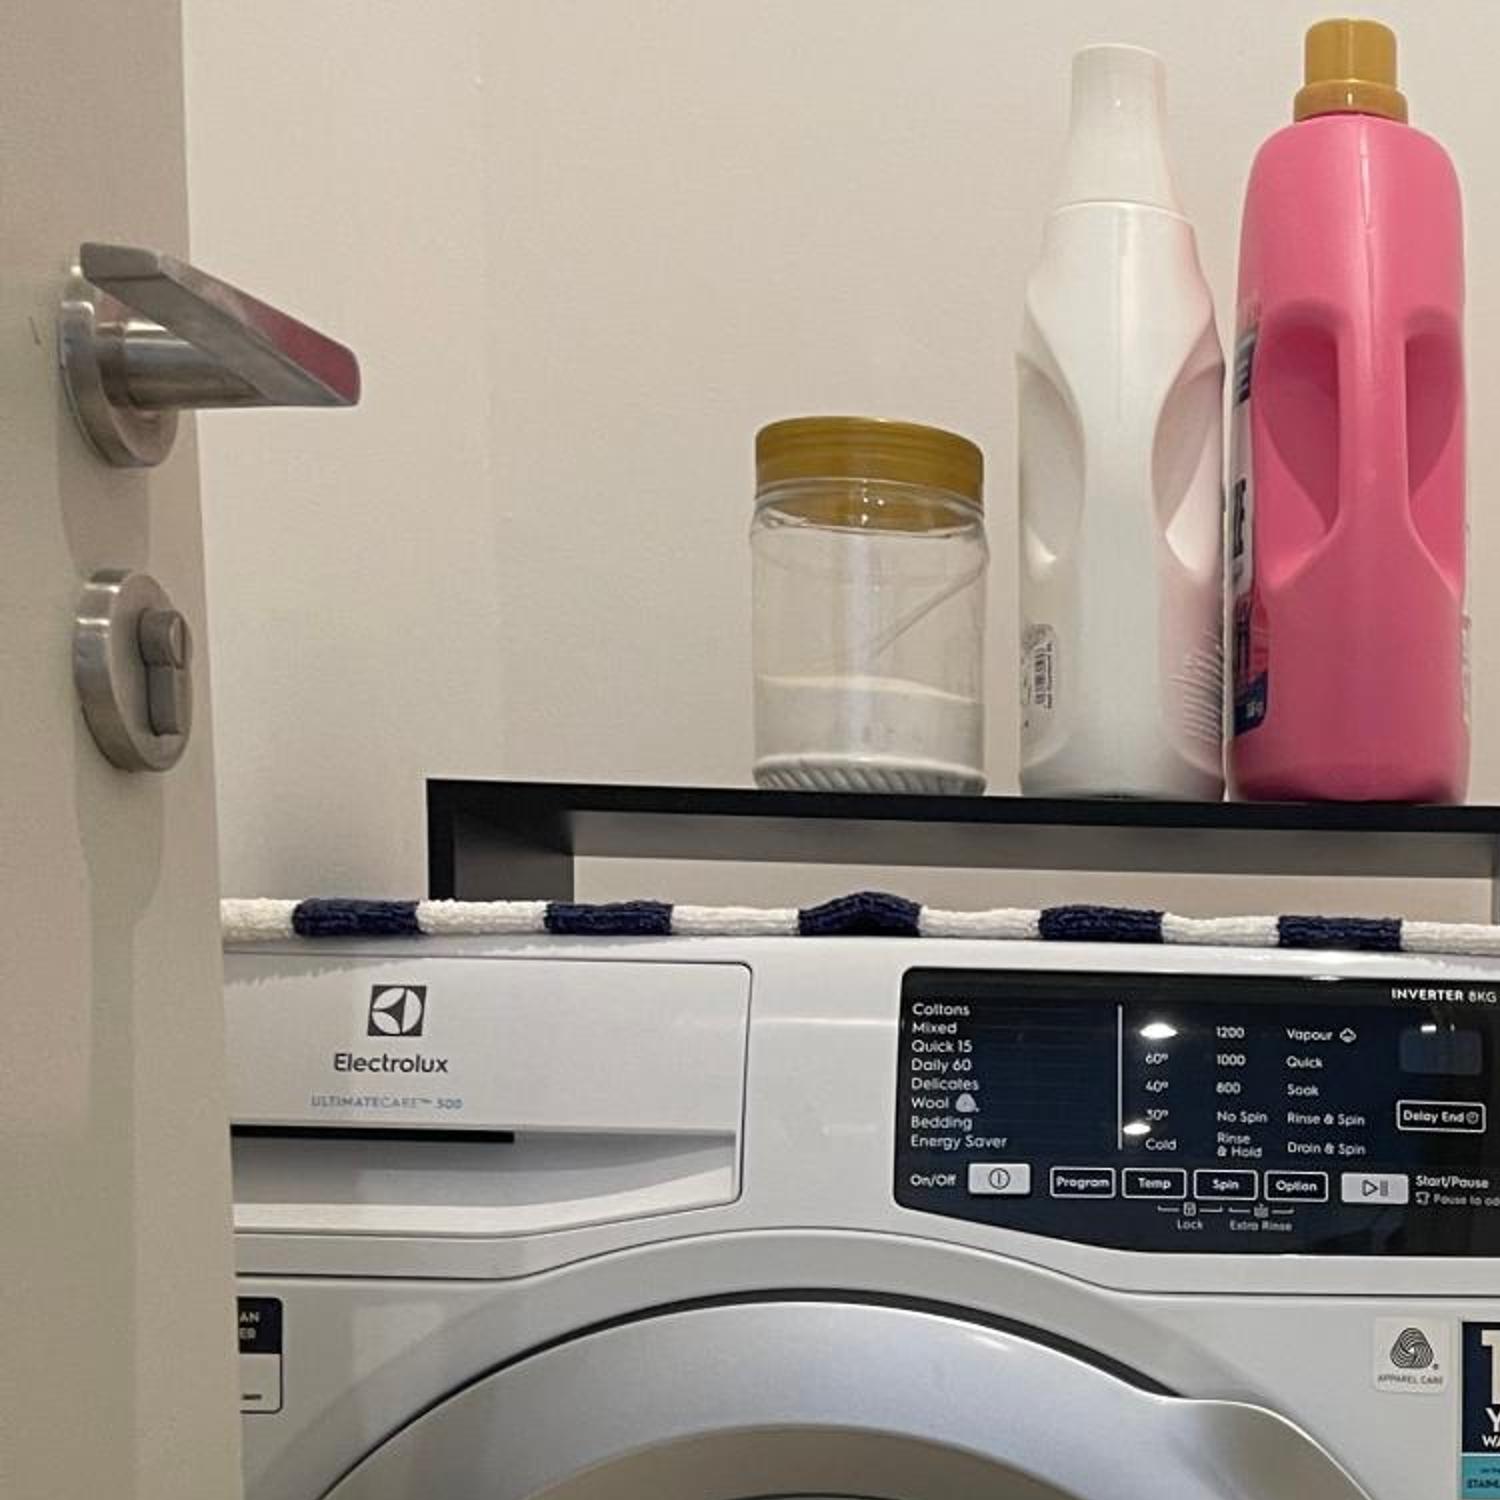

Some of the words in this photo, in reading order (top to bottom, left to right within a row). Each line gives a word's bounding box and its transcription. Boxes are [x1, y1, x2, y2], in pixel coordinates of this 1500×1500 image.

[1391, 988, 1463, 1002] INVERTER
[1468, 991, 1497, 1003] 8KG
[911, 1003, 971, 1016] Cottons
[911, 1022, 958, 1035] Mixed
[1216, 1026, 1245, 1038] 1200
[1286, 1028, 1333, 1042] Vapour
[911, 1040, 954, 1053] Quick
[958, 1040, 973, 1053] 15
[334, 1053, 448, 1073] Electrolux
[911, 1058, 949, 1074] Daily
[952, 1059, 973, 1072] 60
[1217, 1054, 1246, 1066] 1000
[1286, 1056, 1323, 1069] Quick
[911, 1077, 980, 1091] Delicates
[1216, 1082, 1241, 1094] 800
[1287, 1083, 1319, 1096] Soak
[911, 1097, 949, 1109] Wool
[1217, 1111, 1237, 1123] No
[1240, 1111, 1268, 1124] Spin
[1287, 1112, 1320, 1125] Rinse
[1323, 1112, 1335, 1125] &
[1337, 1112, 1366, 1127] Spin
[1403, 1109, 1438, 1124] Delay
[1441, 1111, 1464, 1123] End
[911, 1116, 973, 1132] Bedding
[911, 1135, 961, 1150] Energy
[965, 1135, 1009, 1149] Saver
[1145, 1138, 1177, 1150] Cold
[1217, 1132, 1250, 1144] Rinse
[1217, 1146, 1227, 1158] &
[1231, 1146, 1262, 1158] Hold
[1287, 1141, 1320, 1154] Drain
[1323, 1142, 1335, 1155] &
[1337, 1143, 1366, 1157] Spin
[910, 1173, 957, 1188] On/Off
[1056, 1176, 1110, 1190] Program
[1138, 1177, 1171, 1190] Temp
[1212, 1178, 1239, 1191] Spin
[1275, 1180, 1318, 1193] Option
[1416, 1175, 1490, 1189] Start/Pause
[1433, 1194, 1467, 1205] Pause
[1470, 1195, 1482, 1206] to
[1177, 1220, 1203, 1230] Lock
[1230, 1220, 1259, 1231] Extra
[1261, 1220, 1293, 1231] Rinse
[240, 1311, 260, 1323] AN
